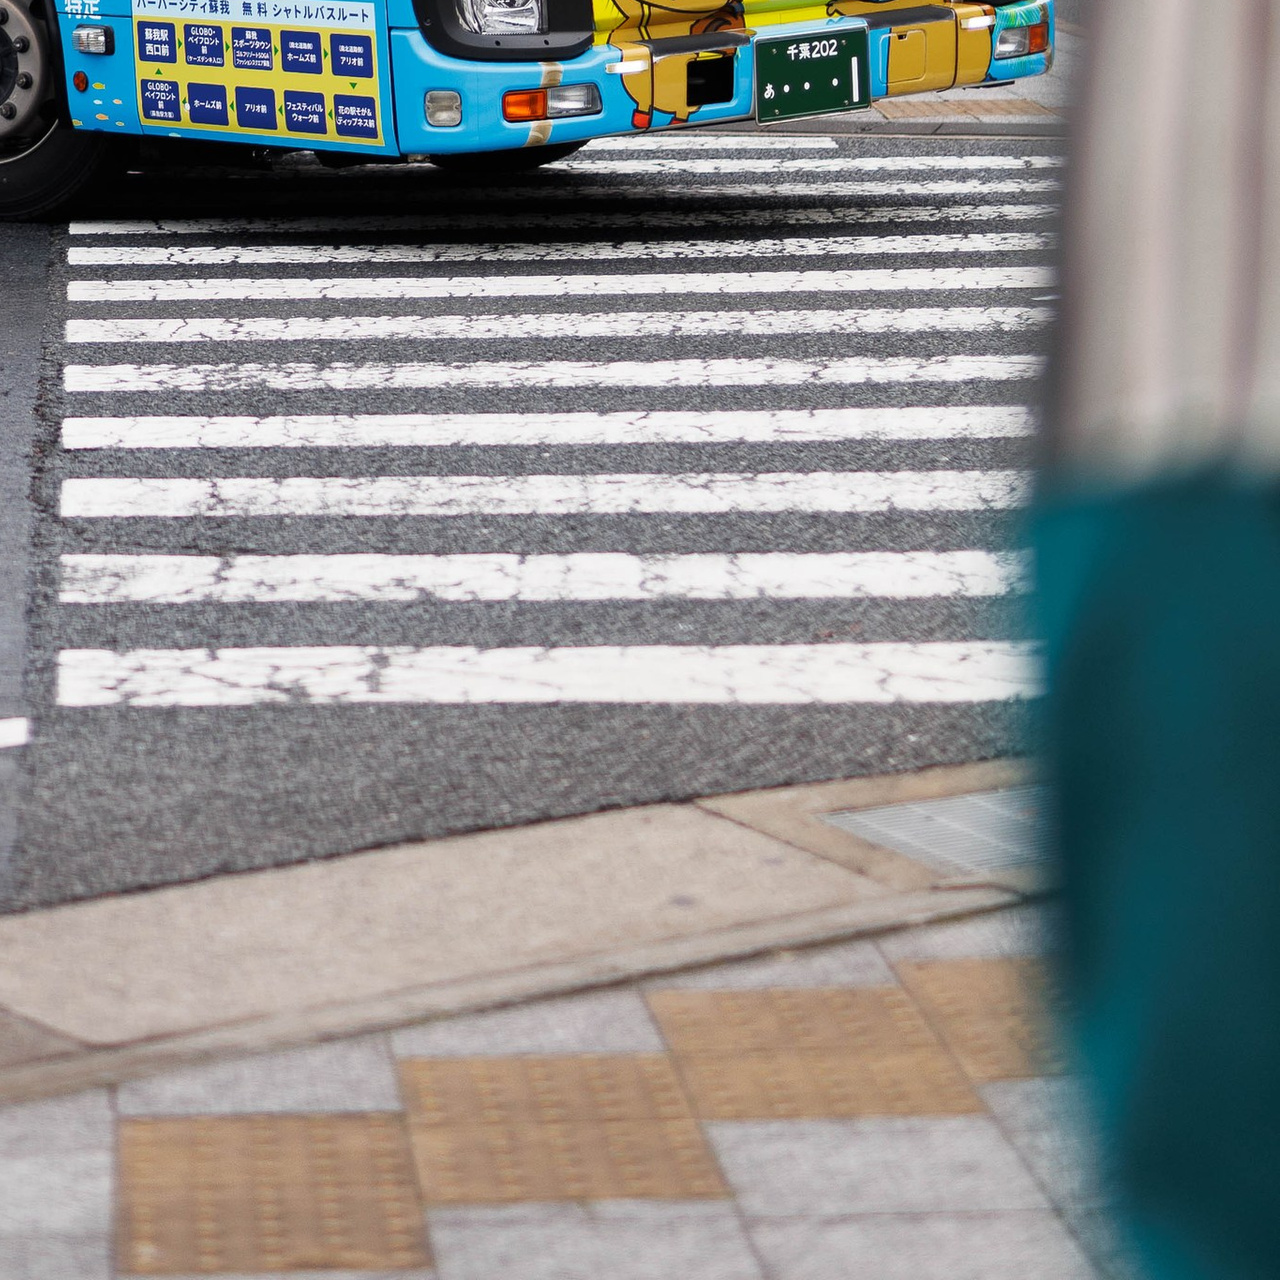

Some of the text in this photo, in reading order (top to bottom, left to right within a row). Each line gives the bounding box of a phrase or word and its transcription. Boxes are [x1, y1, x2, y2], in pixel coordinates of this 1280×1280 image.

[272, 4, 369, 22] シャトルバスルート
[144, 28, 169, 42] 蘇我駅
[145, 43, 170, 57] 西口前
[287, 53, 317, 63] ホームズ前
[340, 57, 364, 67] アリオ前
[764, 82, 775, 99] あ
[193, 99, 222, 110] ホームズ前
[245, 103, 267, 114] アリオ前
[286, 101, 324, 113] フェスティバル
[292, 113, 319, 124] ウォーク前
